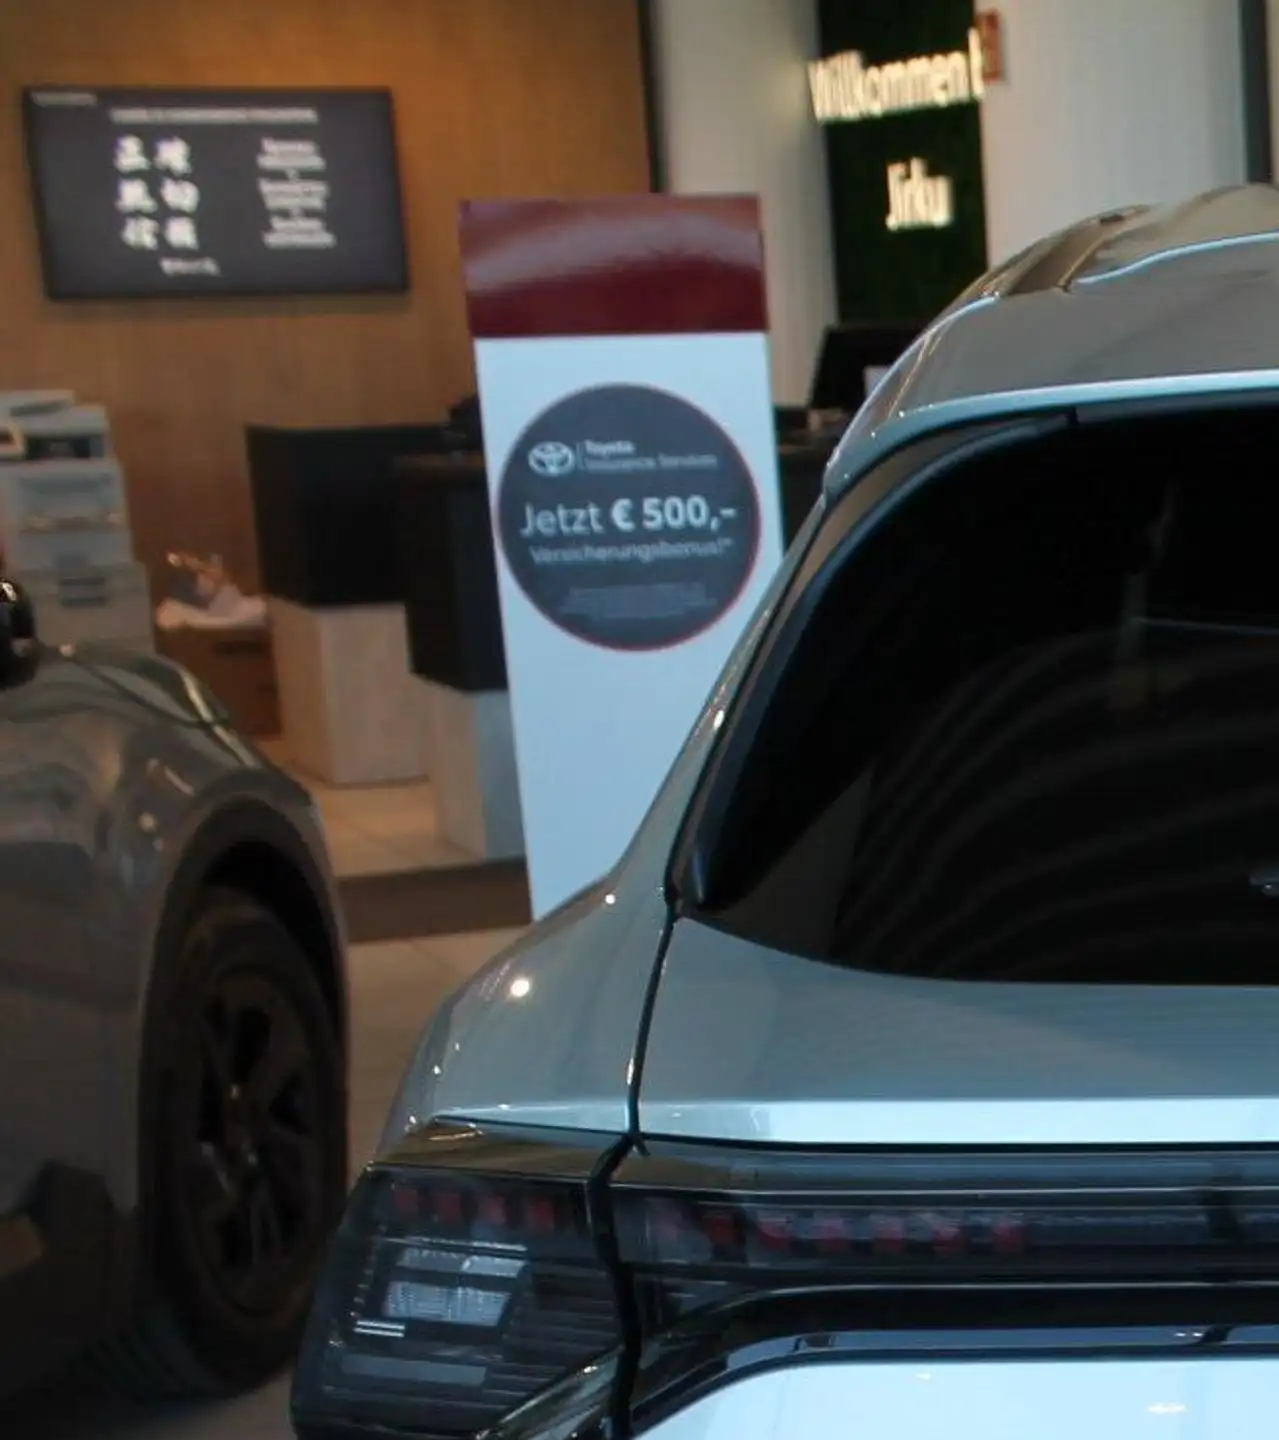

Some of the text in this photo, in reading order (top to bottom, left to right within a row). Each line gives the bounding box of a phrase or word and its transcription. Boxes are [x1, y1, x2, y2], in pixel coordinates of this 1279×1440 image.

[520, 494, 738, 538] Jetzt € 500,-
